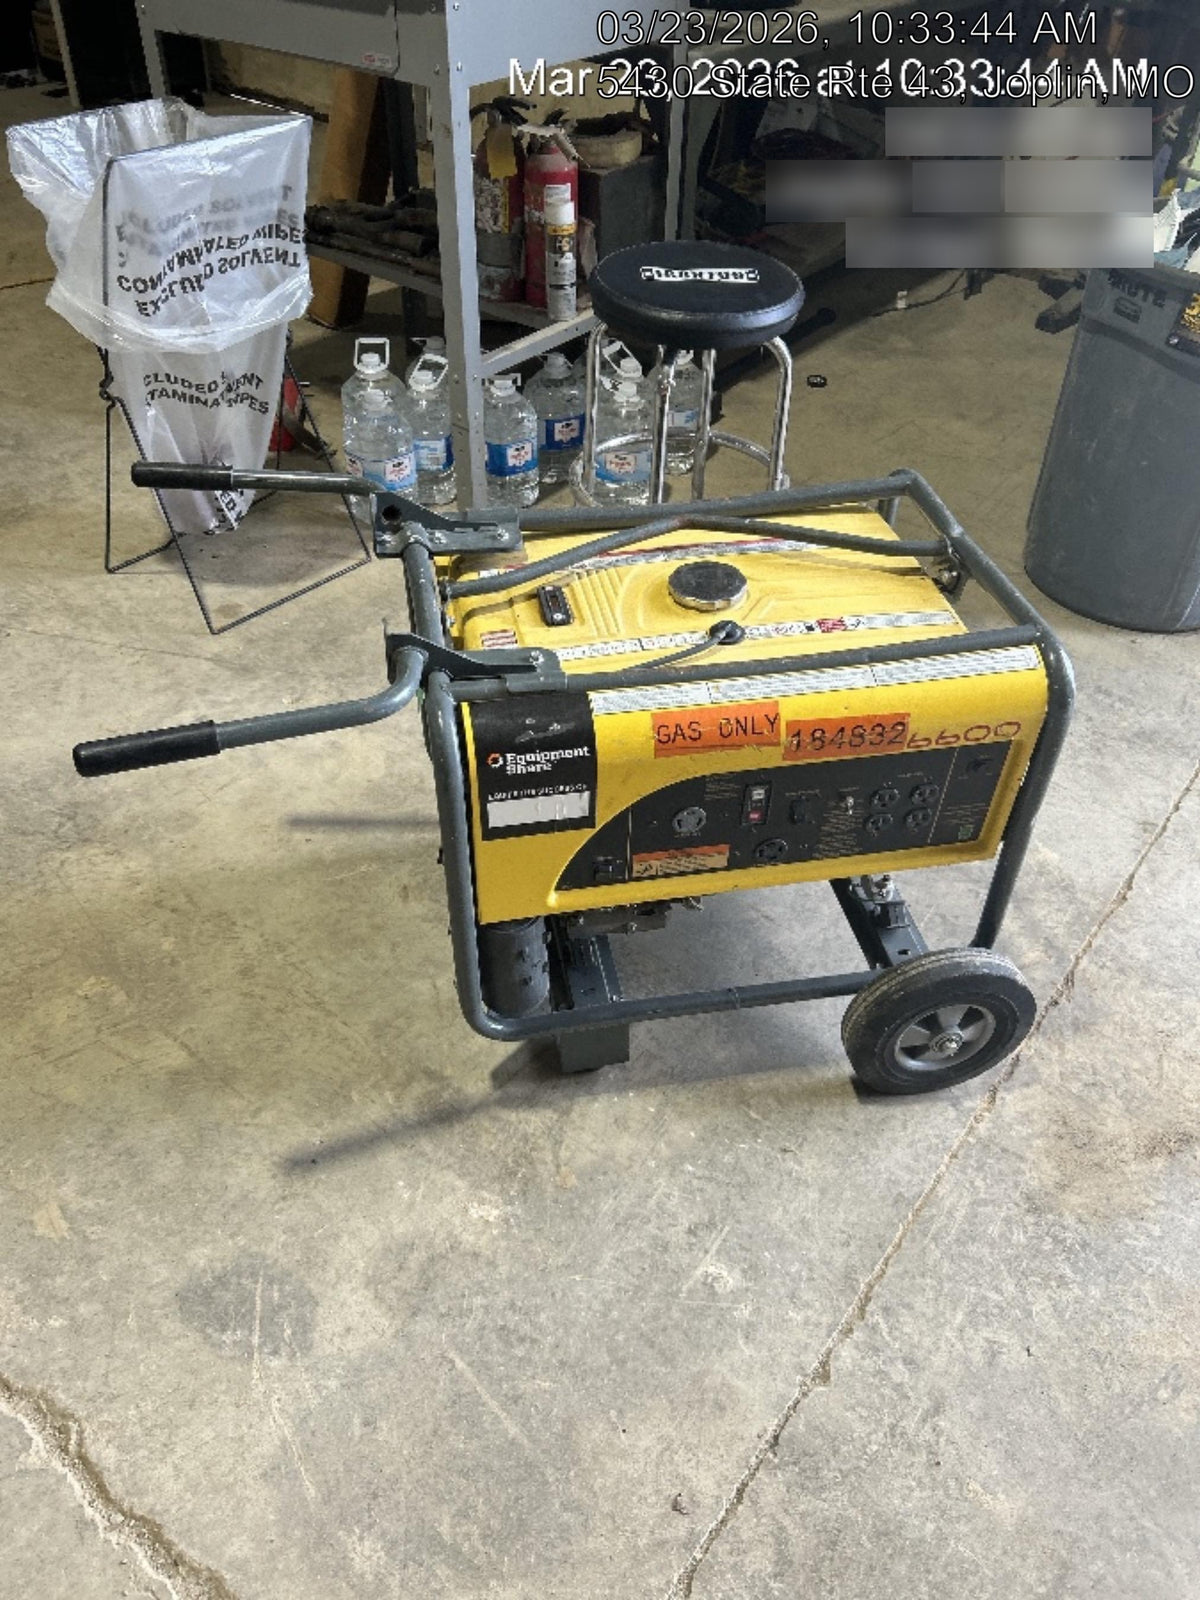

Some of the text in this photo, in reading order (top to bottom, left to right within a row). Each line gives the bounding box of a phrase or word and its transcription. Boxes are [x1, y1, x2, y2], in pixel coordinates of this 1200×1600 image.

[656, 712, 779, 745] GAS ONLY
[505, 746, 591, 767] Equipment
